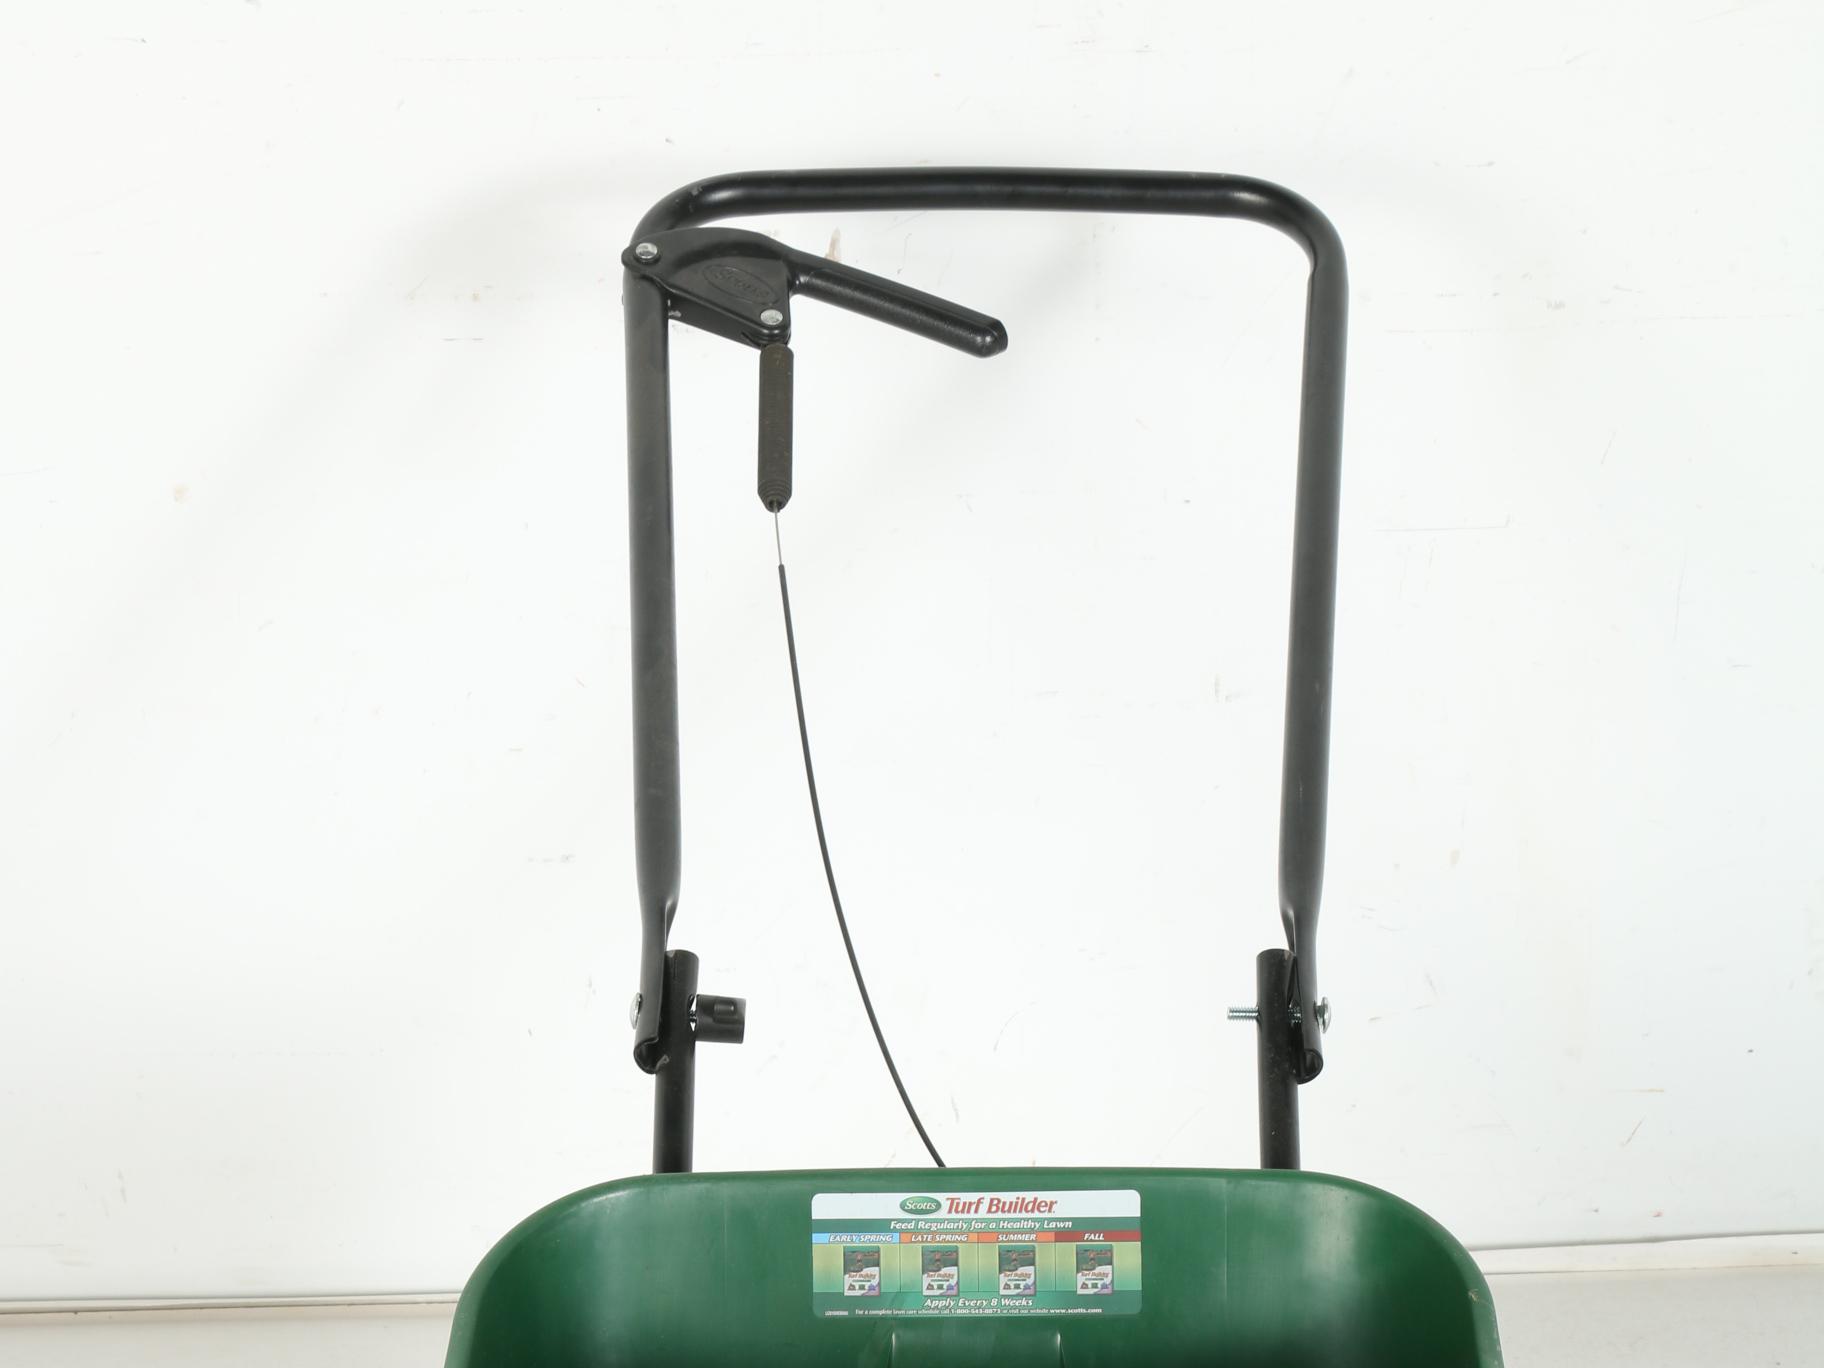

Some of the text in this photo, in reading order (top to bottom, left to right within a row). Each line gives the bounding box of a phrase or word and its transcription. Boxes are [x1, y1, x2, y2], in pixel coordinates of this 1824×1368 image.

[905, 1197, 1058, 1214] Scotts Turf Builder
[890, 1221, 915, 1230] Feed
[917, 1220, 968, 1231] Regularly
[970, 1220, 987, 1231] for
[999, 1220, 1041, 1230] Healthy
[1043, 1220, 1073, 1229] Lawn
[828, 1233, 893, 1243] EARLY SPRING
[911, 1233, 968, 1242] LATE SPRING
[997, 1233, 1036, 1241] SUMMER
[1083, 1233, 1104, 1241] FALL
[924, 1298, 1033, 1308] Apply Every 8 Weeks
